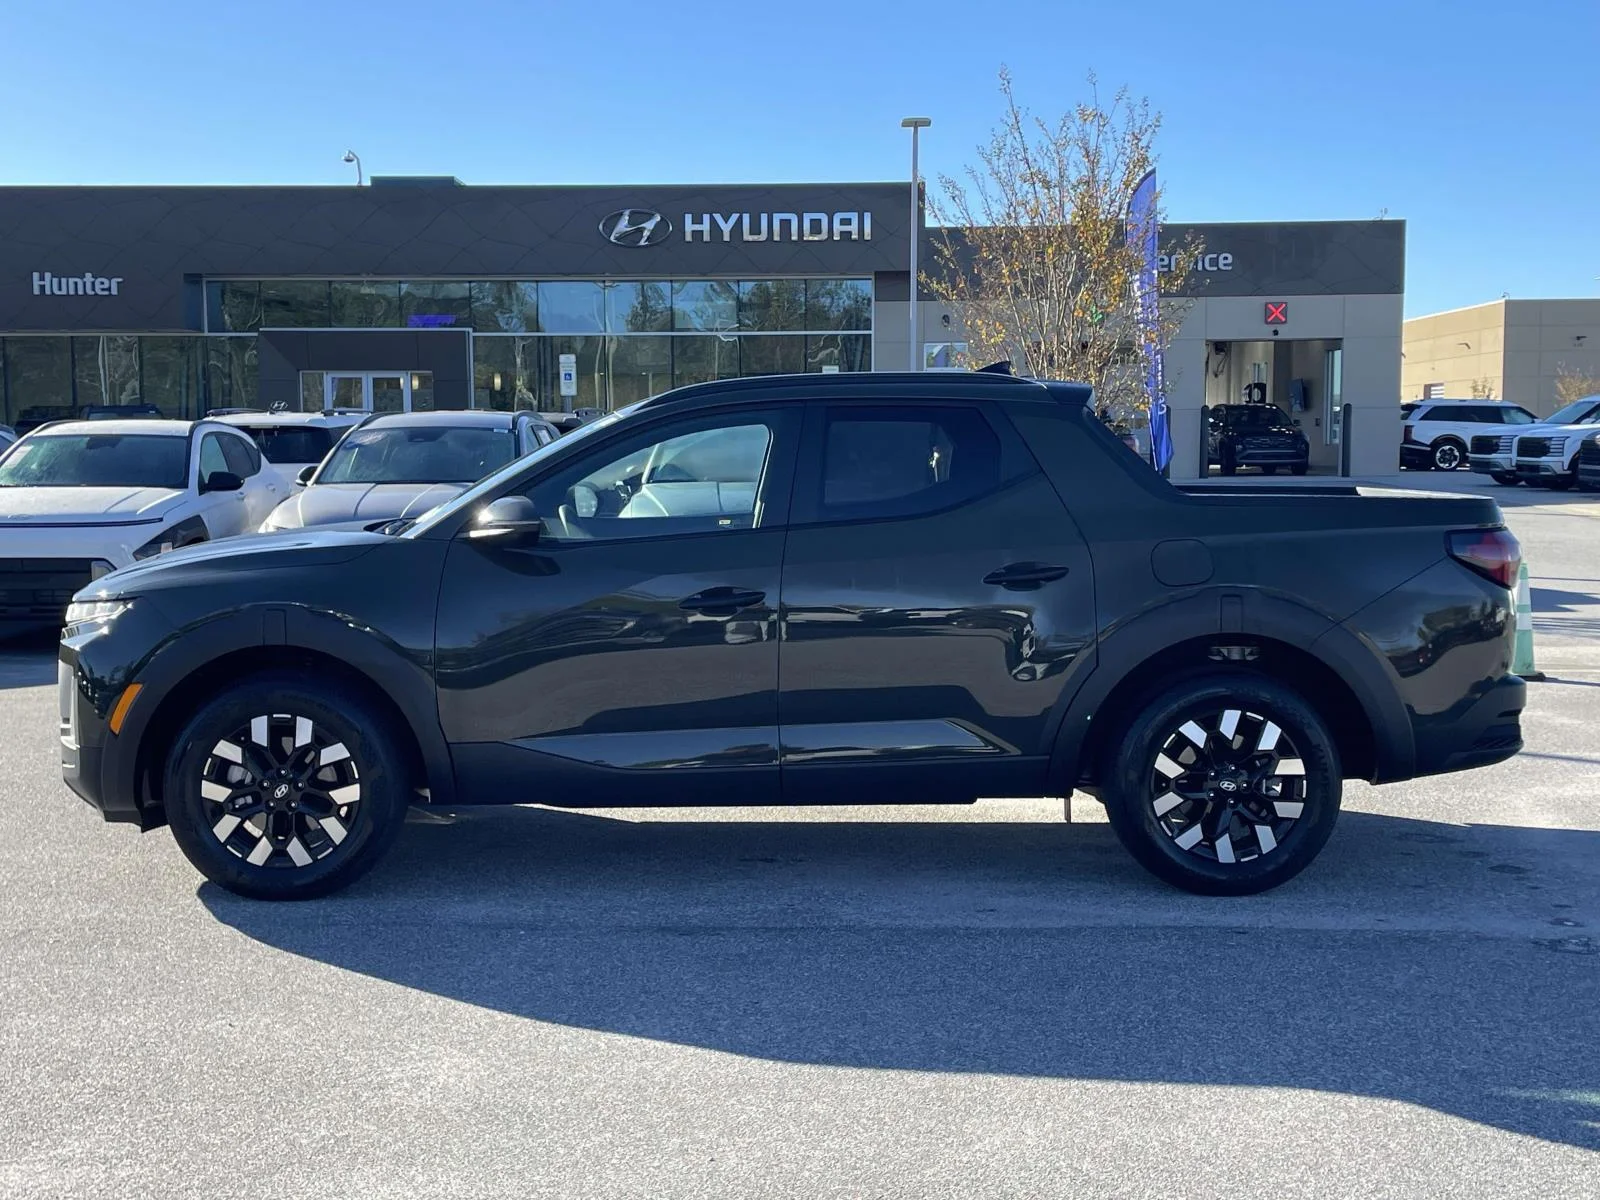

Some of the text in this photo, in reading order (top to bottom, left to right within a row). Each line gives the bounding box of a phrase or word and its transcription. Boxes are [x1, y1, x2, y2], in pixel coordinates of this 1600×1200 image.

[684, 212, 872, 242] HYUNDAI
[1157, 252, 1233, 272] erice
[32, 271, 124, 296] Hunter
